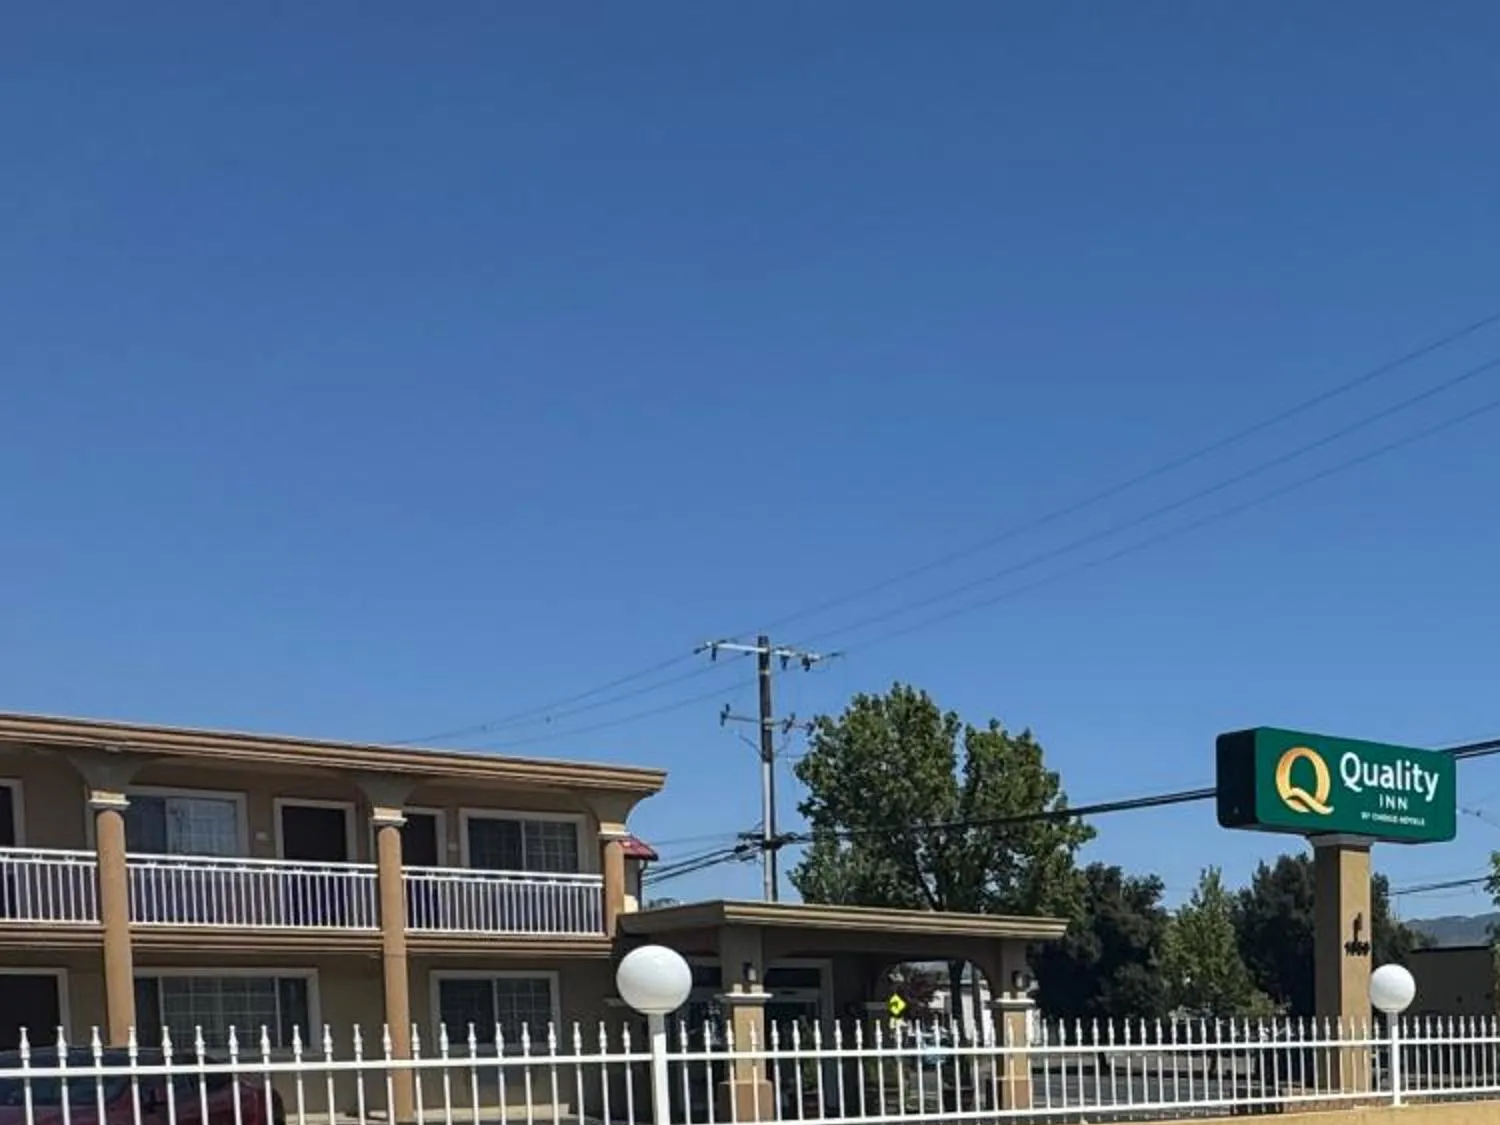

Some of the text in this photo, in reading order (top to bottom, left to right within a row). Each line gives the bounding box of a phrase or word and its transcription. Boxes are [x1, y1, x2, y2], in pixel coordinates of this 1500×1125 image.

[1275, 747, 1334, 814] Q
[1340, 752, 1439, 802] Quality
[1379, 794, 1408, 810] INN
